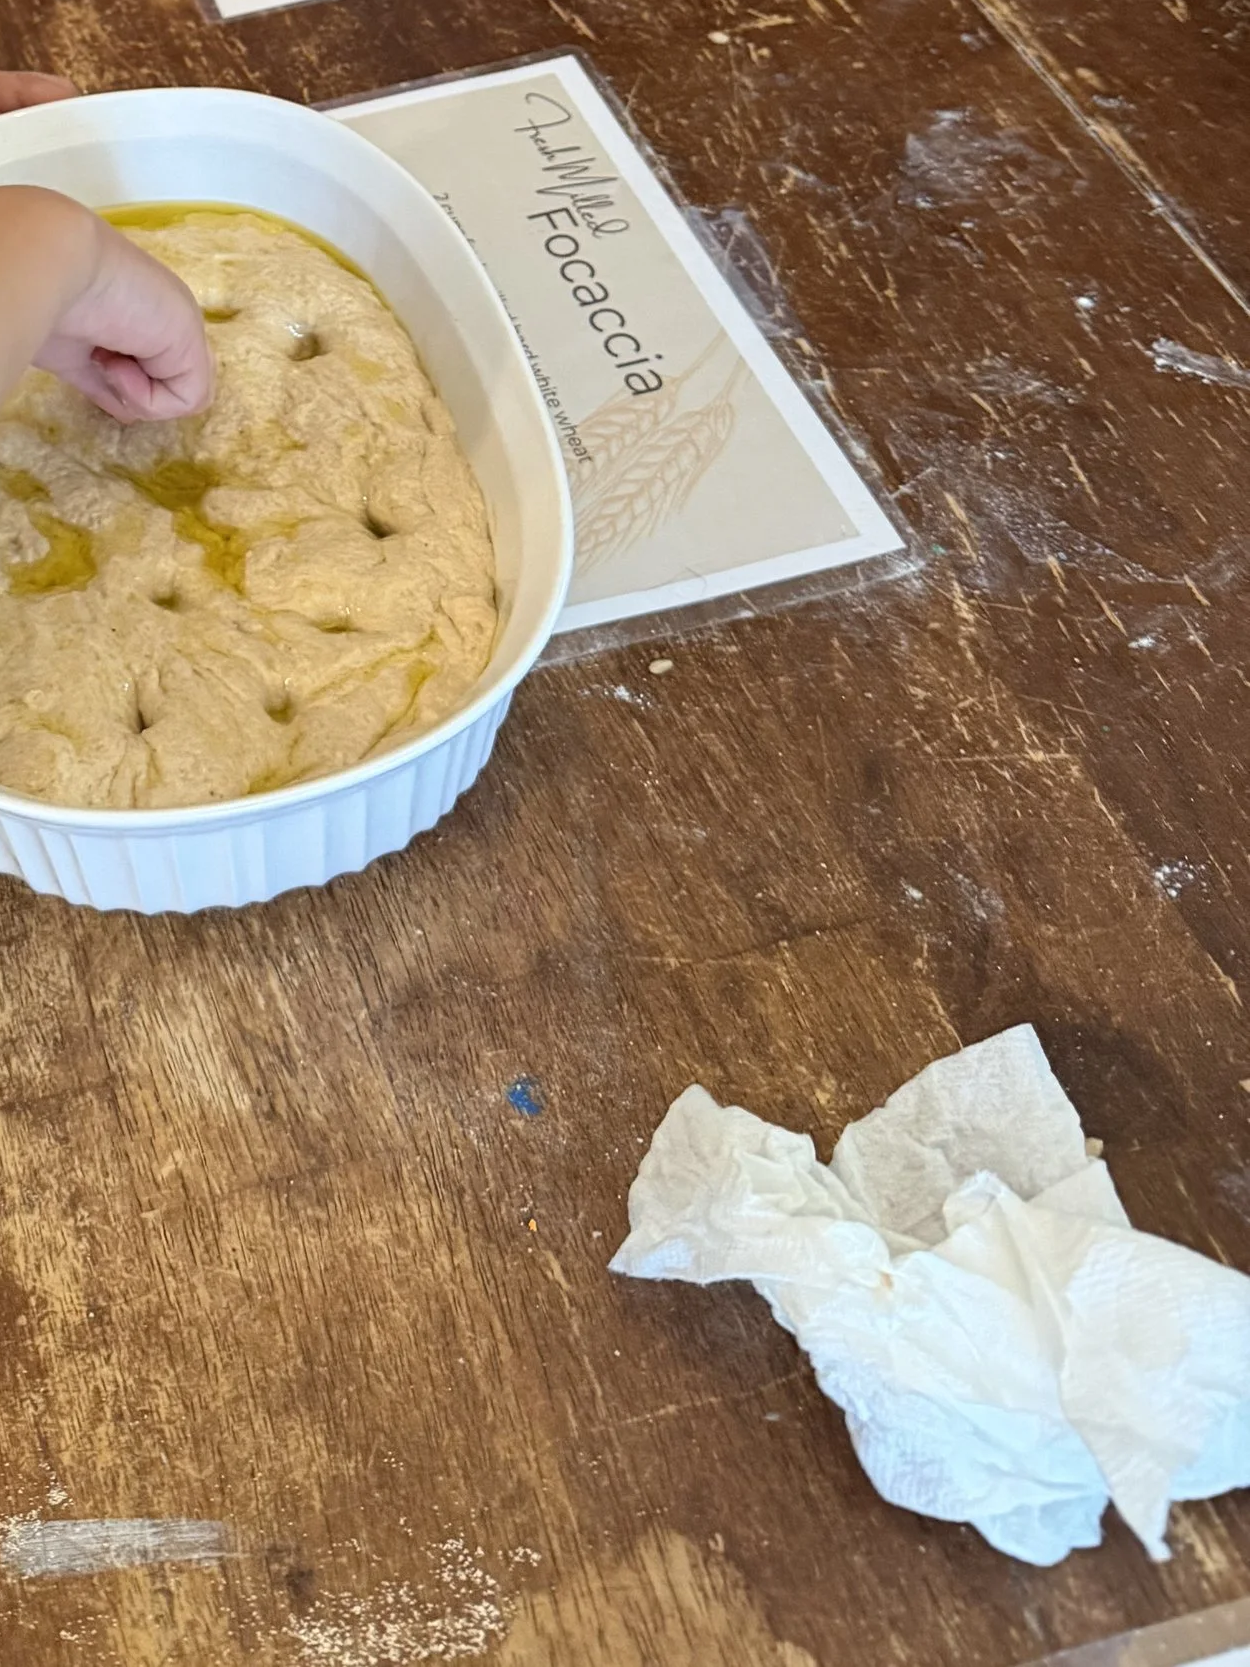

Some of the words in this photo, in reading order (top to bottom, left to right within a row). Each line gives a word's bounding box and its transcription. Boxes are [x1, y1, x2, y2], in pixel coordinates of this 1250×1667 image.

[514, 92, 581, 162] Fresh
[536, 157, 630, 239] Milled
[527, 207, 664, 397] Focaccia
[530, 361, 561, 409] white
[554, 409, 594, 464] wheat
